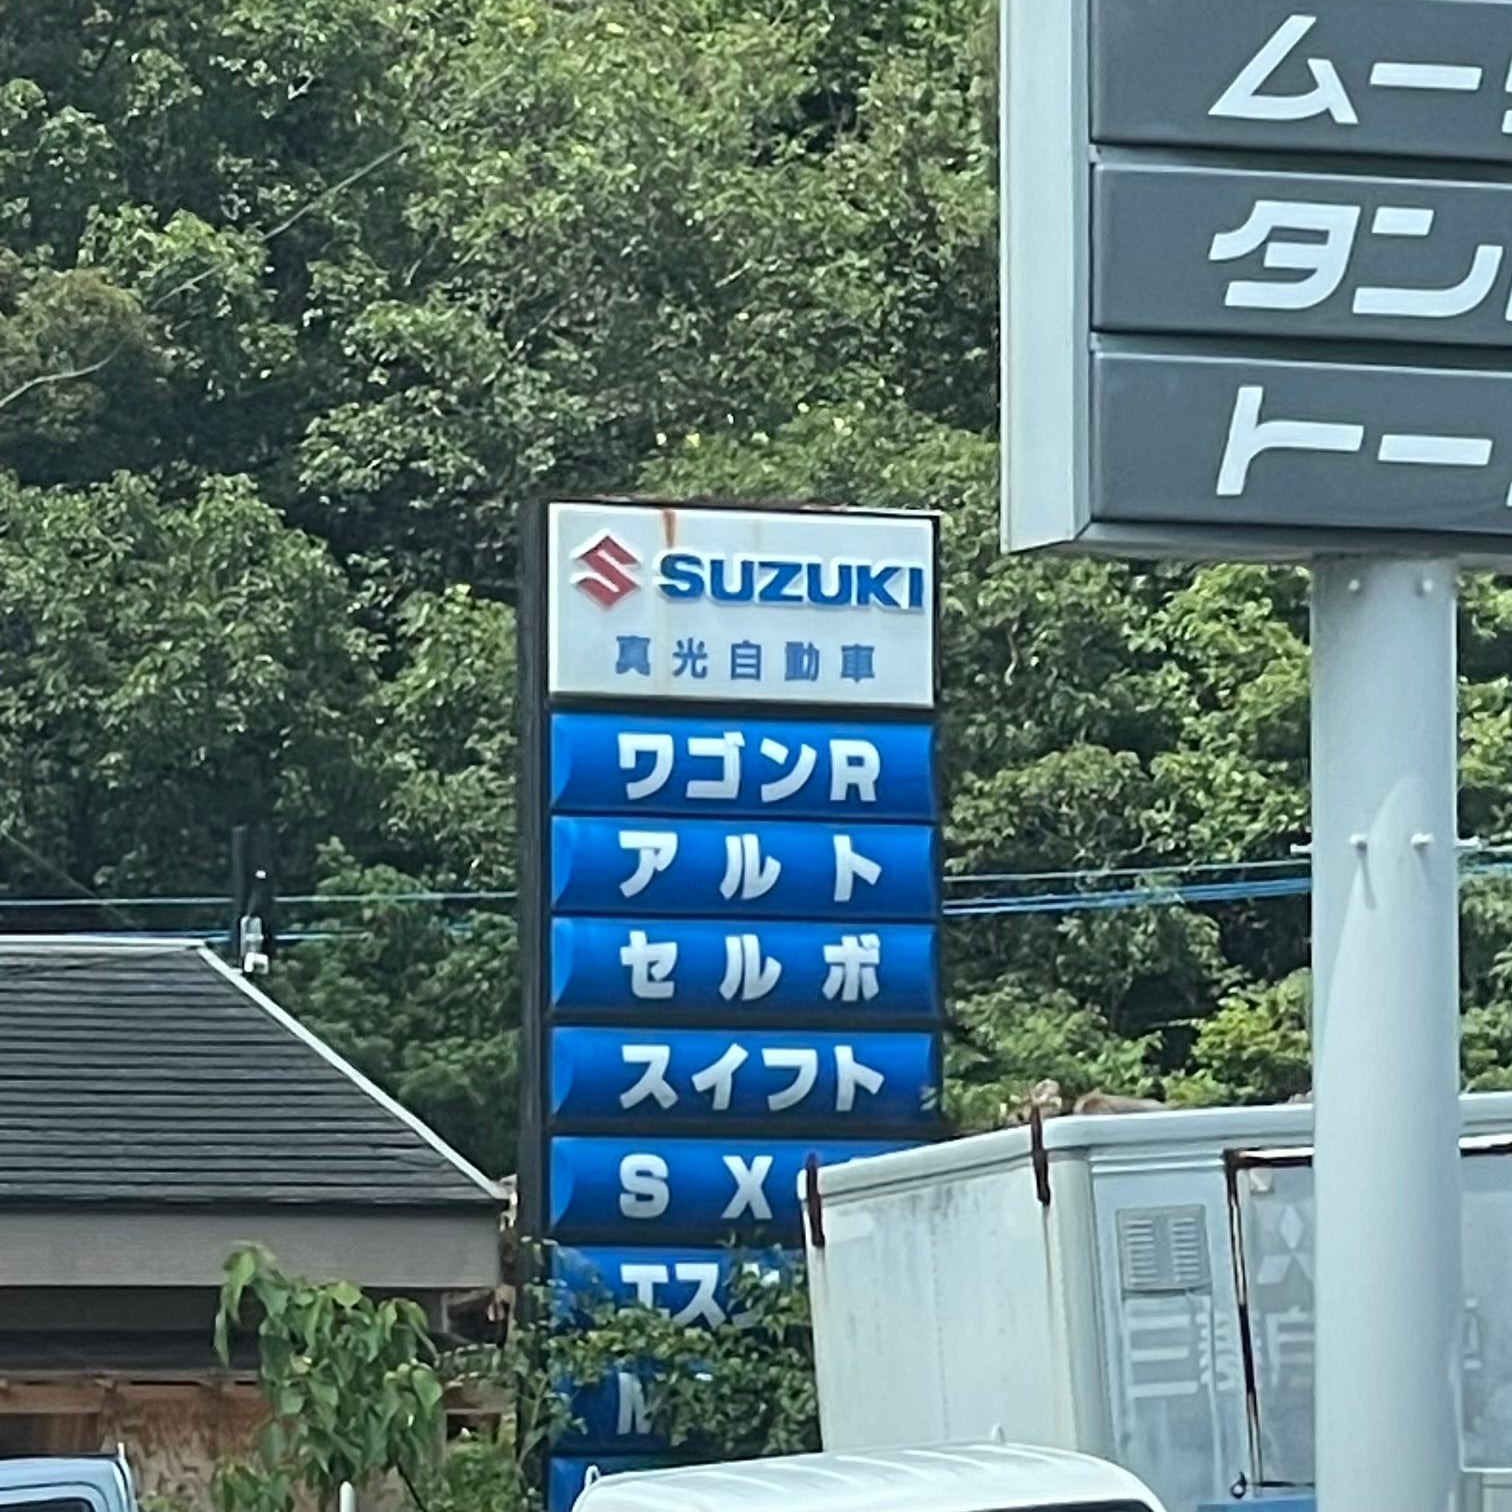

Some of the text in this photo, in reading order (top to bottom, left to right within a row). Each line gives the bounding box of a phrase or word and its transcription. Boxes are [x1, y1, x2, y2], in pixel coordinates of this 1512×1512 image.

[658, 553, 926, 610] SUZUKI
[615, 634, 876, 683] 真光自動車
[617, 730, 881, 803] ワゴンR
[618, 831, 882, 902] アルト
[620, 930, 881, 1001] セルボ
[619, 1043, 884, 1111] スイフト
